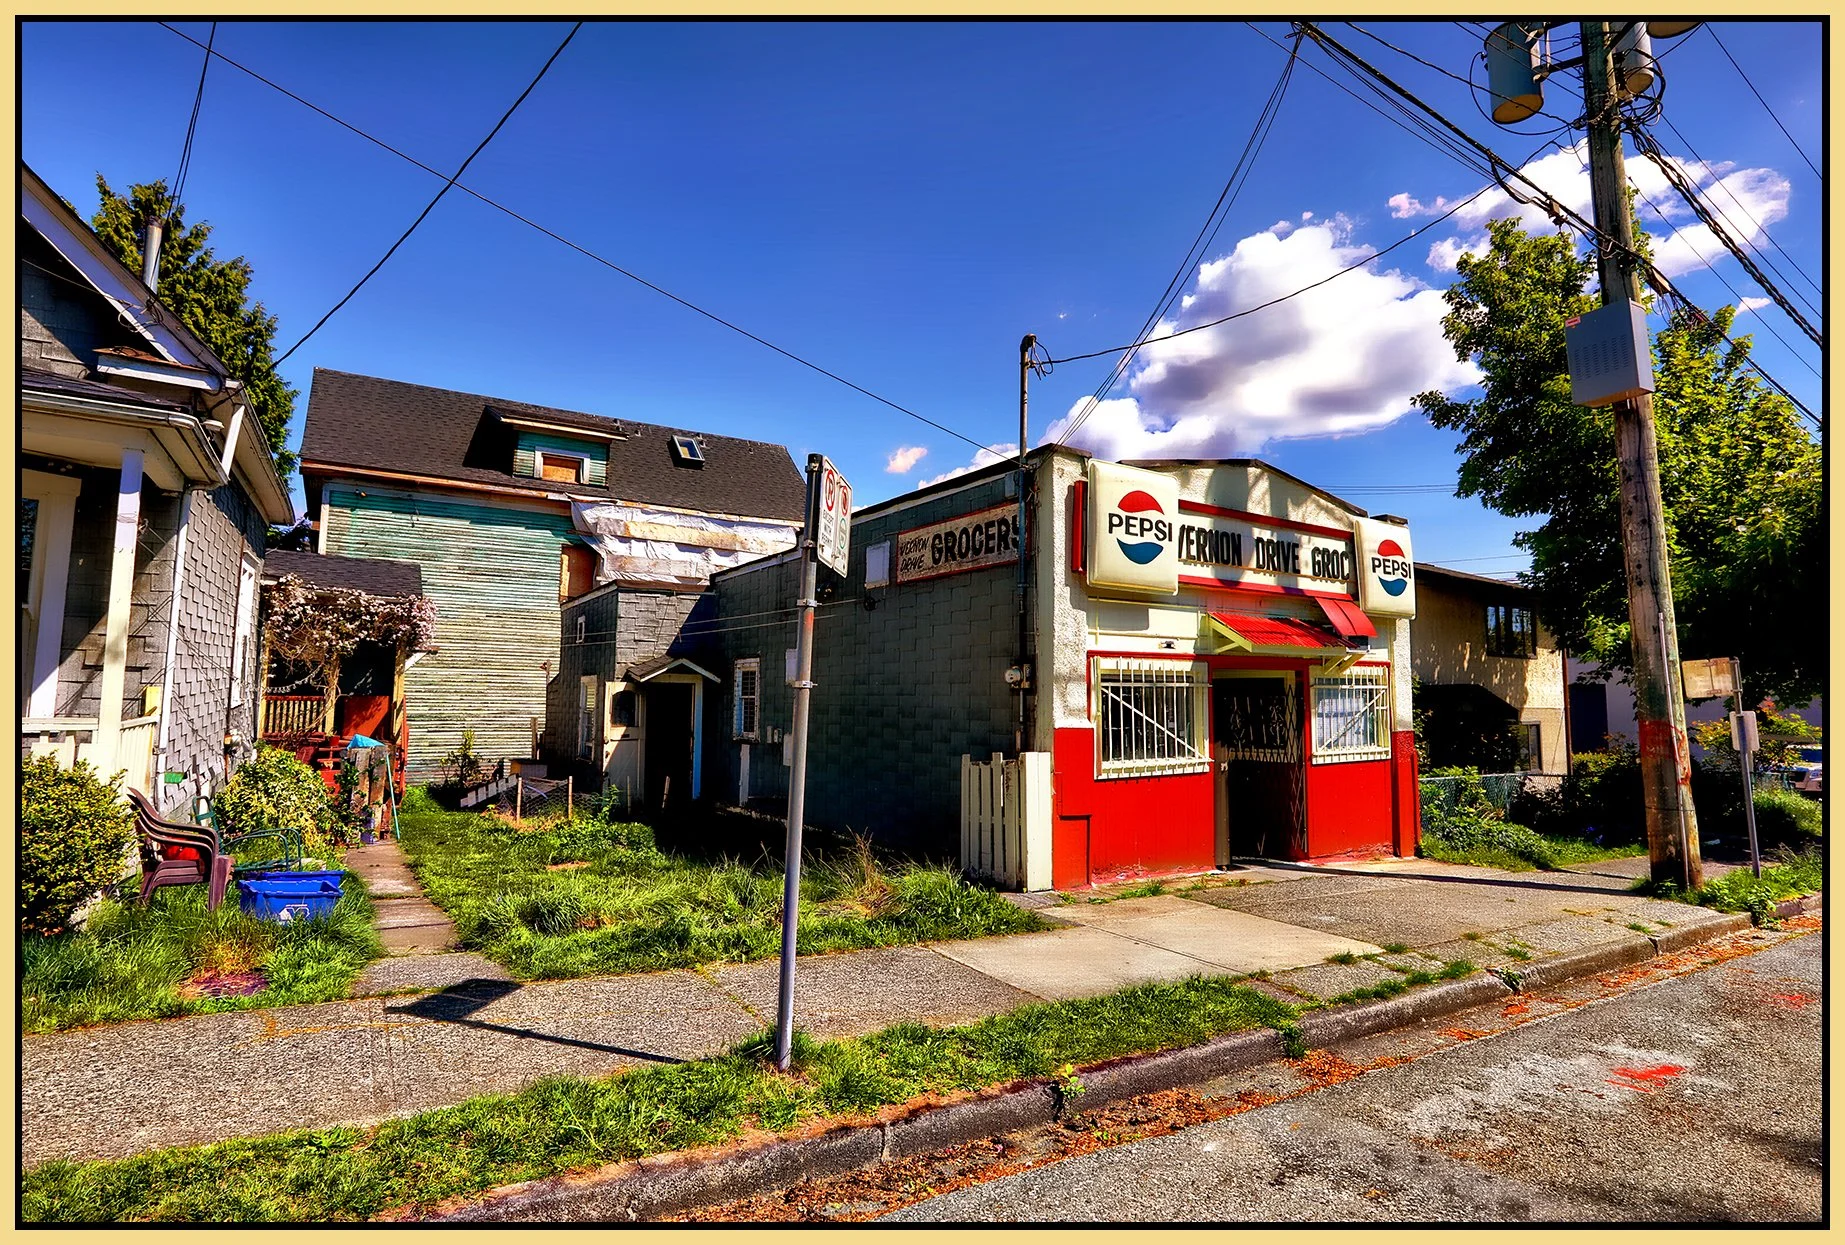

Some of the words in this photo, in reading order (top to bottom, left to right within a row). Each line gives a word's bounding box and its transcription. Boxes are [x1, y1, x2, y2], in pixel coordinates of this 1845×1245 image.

[1108, 512, 1173, 542] PEPSI
[900, 554, 925, 572] DRIVE
[1256, 536, 1300, 574] DRIVE
[1311, 546, 1350, 580] GROC
[1371, 556, 1412, 579] PEPSI
